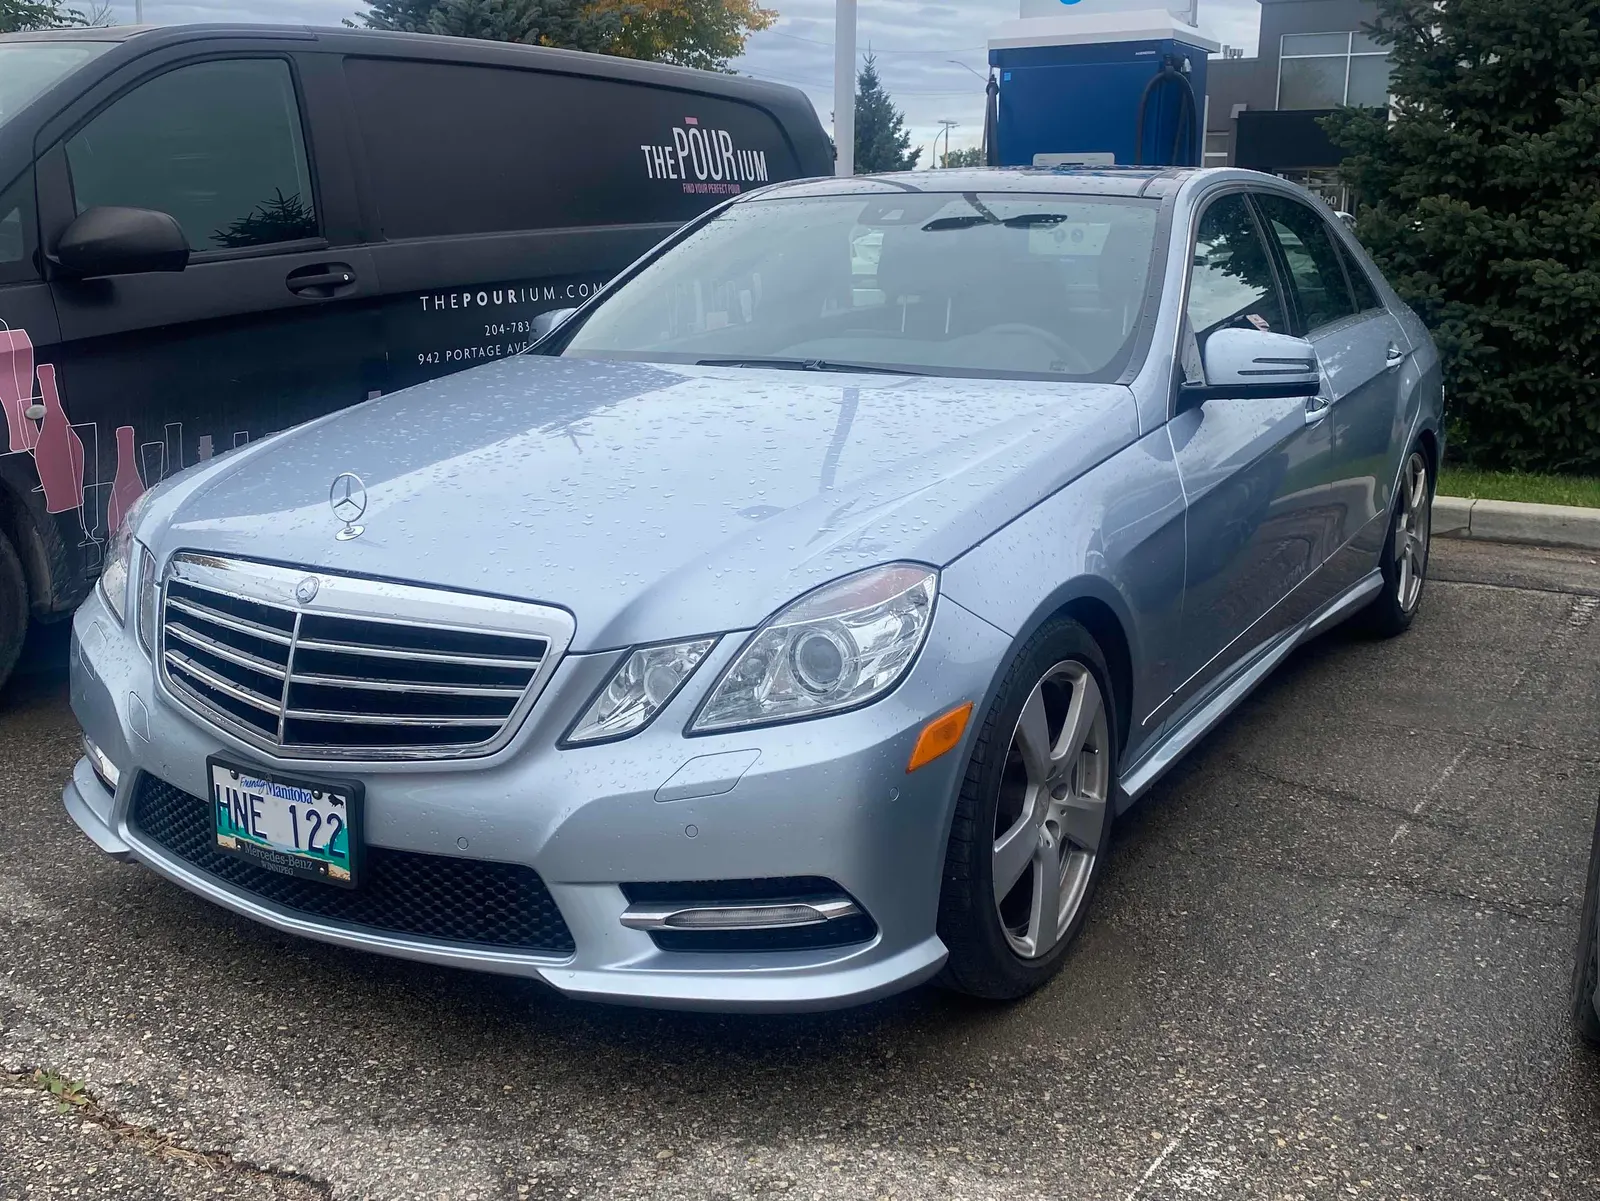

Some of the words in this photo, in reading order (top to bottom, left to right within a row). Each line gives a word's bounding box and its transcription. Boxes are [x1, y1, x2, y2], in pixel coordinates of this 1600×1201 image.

[707, 183, 728, 194] PERFECT
[418, 352, 440, 365] 942
[446, 344, 501, 362] PORTAGE
[507, 341, 527, 355] AVE
[266, 783, 313, 804] Manitoba
[215, 784, 267, 839] HNE
[289, 804, 346, 859] 122
[245, 841, 313, 871] Mercedes-Benz
[261, 859, 294, 875] WINNIPEG
